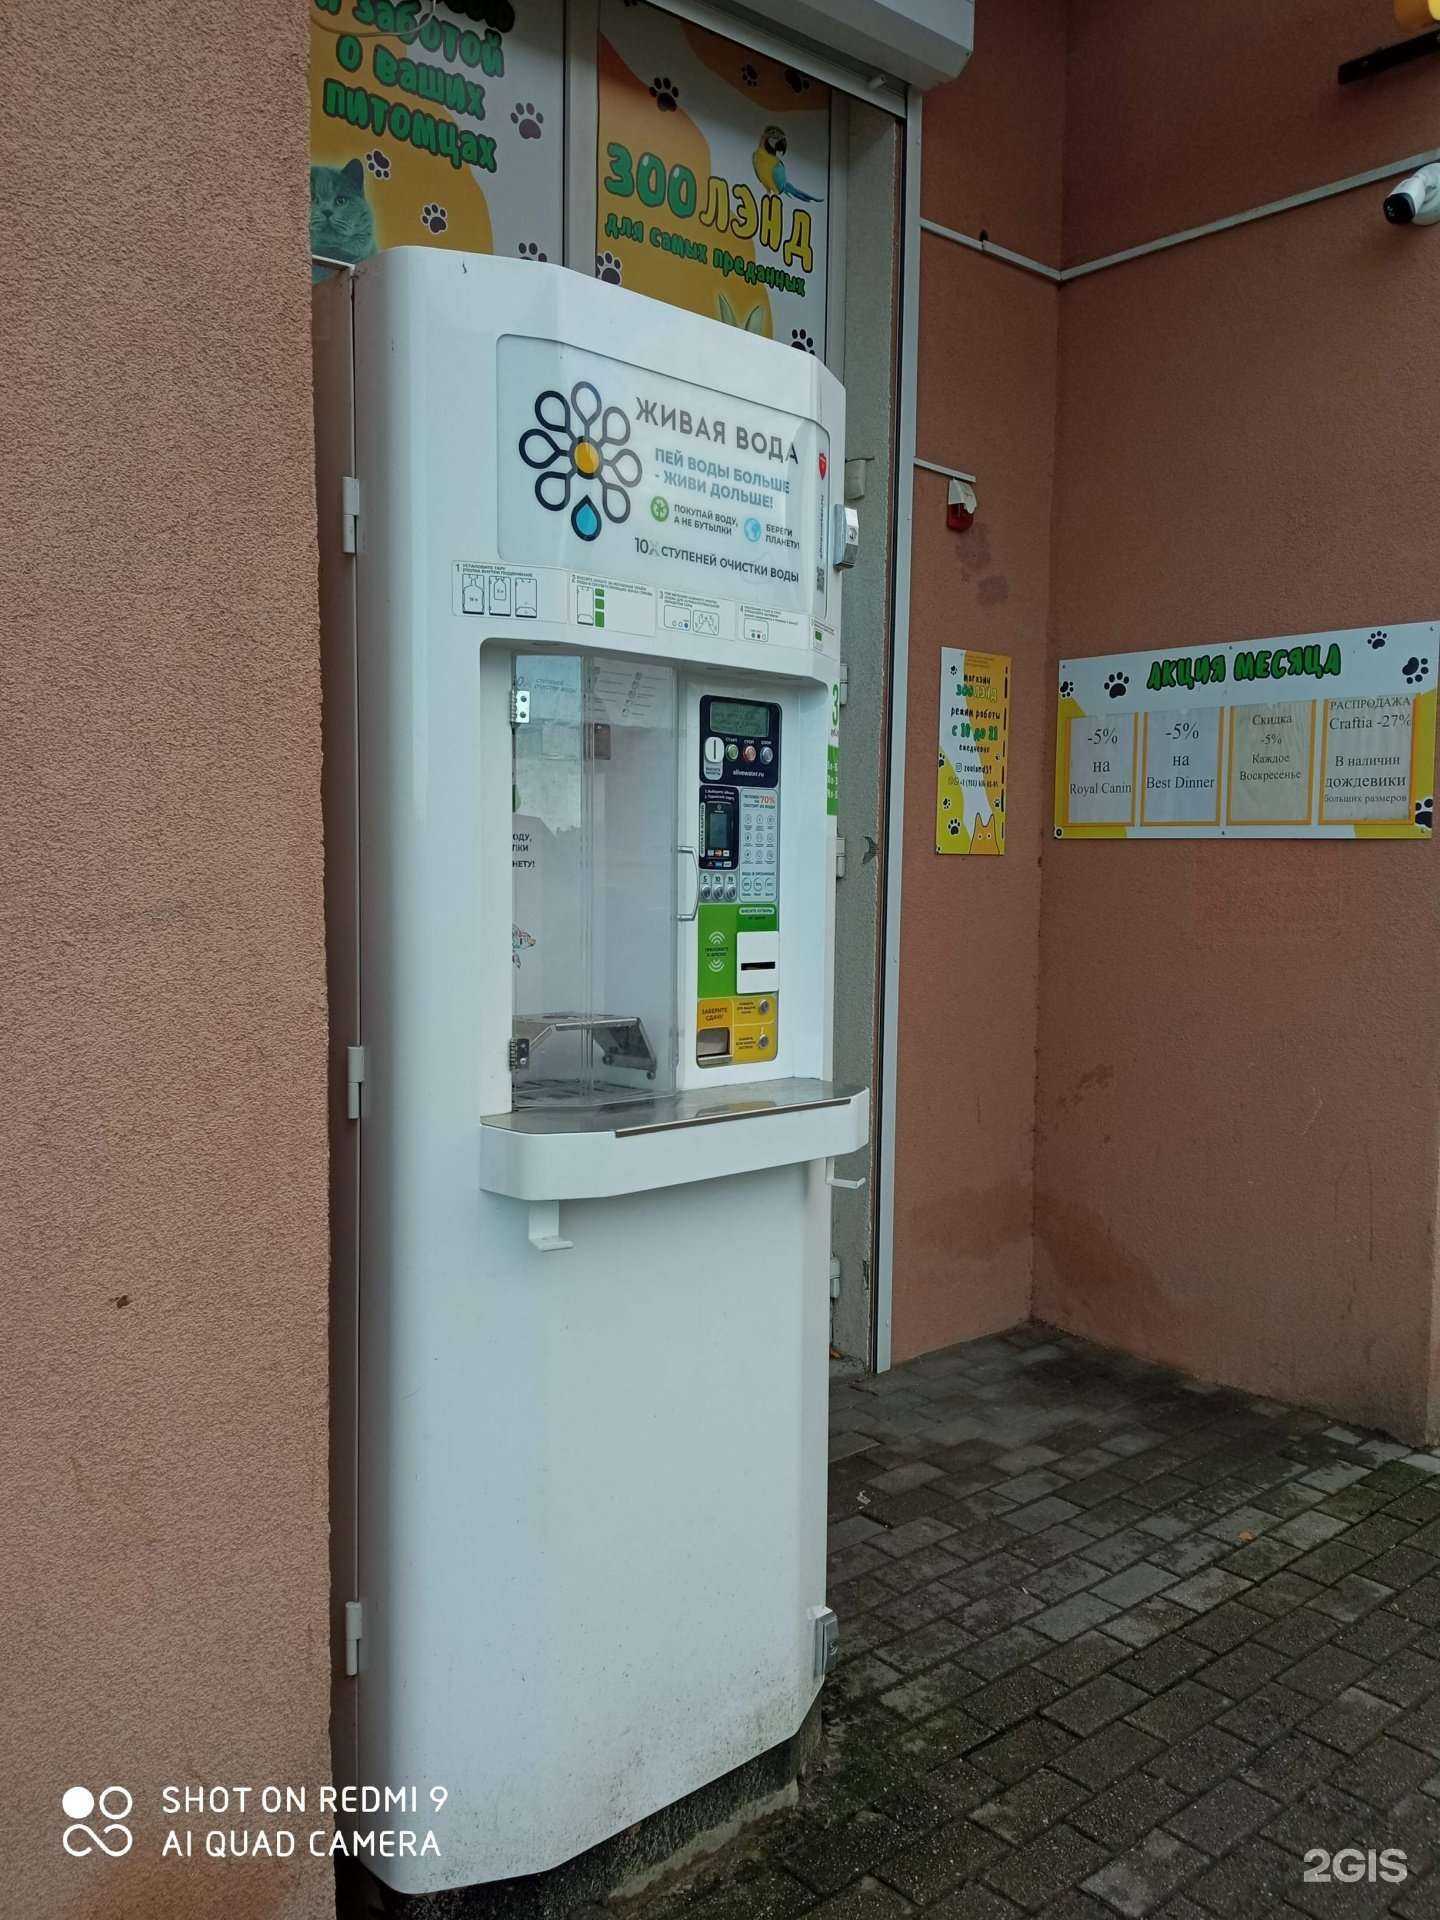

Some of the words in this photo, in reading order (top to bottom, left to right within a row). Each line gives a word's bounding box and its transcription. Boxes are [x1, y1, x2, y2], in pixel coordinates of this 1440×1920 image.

[323, 77, 497, 173] питомцах
[605, 213, 644, 243] для
[650, 227, 708, 264] самых
[713, 248, 805, 297] преданных
[635, 397, 725, 444] ЖИВАЯ
[736, 426, 799, 464] ВОДА
[655, 447, 684, 468] ПЕЙ
[688, 456, 730, 480] ВОДЫ
[733, 468, 791, 494] БОЛЬШЕ
[664, 469, 706, 493] ЖИВИ
[711, 482, 774, 509] ДОЛЬШЕ!
[674, 503, 714, 519] ПОКУПАЙ
[715, 514, 739, 527] ВОДУ,
[674, 515, 680, 524] А
[682, 517, 692, 527] НЕ
[694, 519, 732, 535] БУТЫЛКИ
[766, 523, 793, 537] БЕРЕГИ
[661, 546, 717, 566] СТУПЕНЕЙ
[719, 557, 768, 577] ОЧИСТКИ
[770, 567, 799, 583] ВОДЫ
[1146, 654, 1227, 691] АКЦИЯ
[1233, 643, 1342, 682] МЕСЯЦА
[1329, 696, 1411, 711] РАСПРОДАЖА
[1252, 714, 1292, 727] Скидка
[1329, 716, 1373, 730] Craftia
[1087, 727, 1118, 745] -5%
[1165, 721, 1200, 741] -5%
[1260, 733, 1283, 745] -5%
[1092, 760, 1111, 773] на
[1172, 755, 1190, 767] на
[1251, 753, 1290, 765] Каждое
[1335, 755, 1344, 767] В
[1347, 756, 1401, 768] наличии
[1146, 776, 1171, 790] Best
[1174, 776, 1215, 790] Dinner
[1240, 770, 1302, 783] Воскресенье
[1326, 776, 1406, 790] дождевики
[1069, 783, 1098, 797] Royal
[1101, 782, 1132, 795] Canin
[512, 833, 532, 842] ОДУ,
